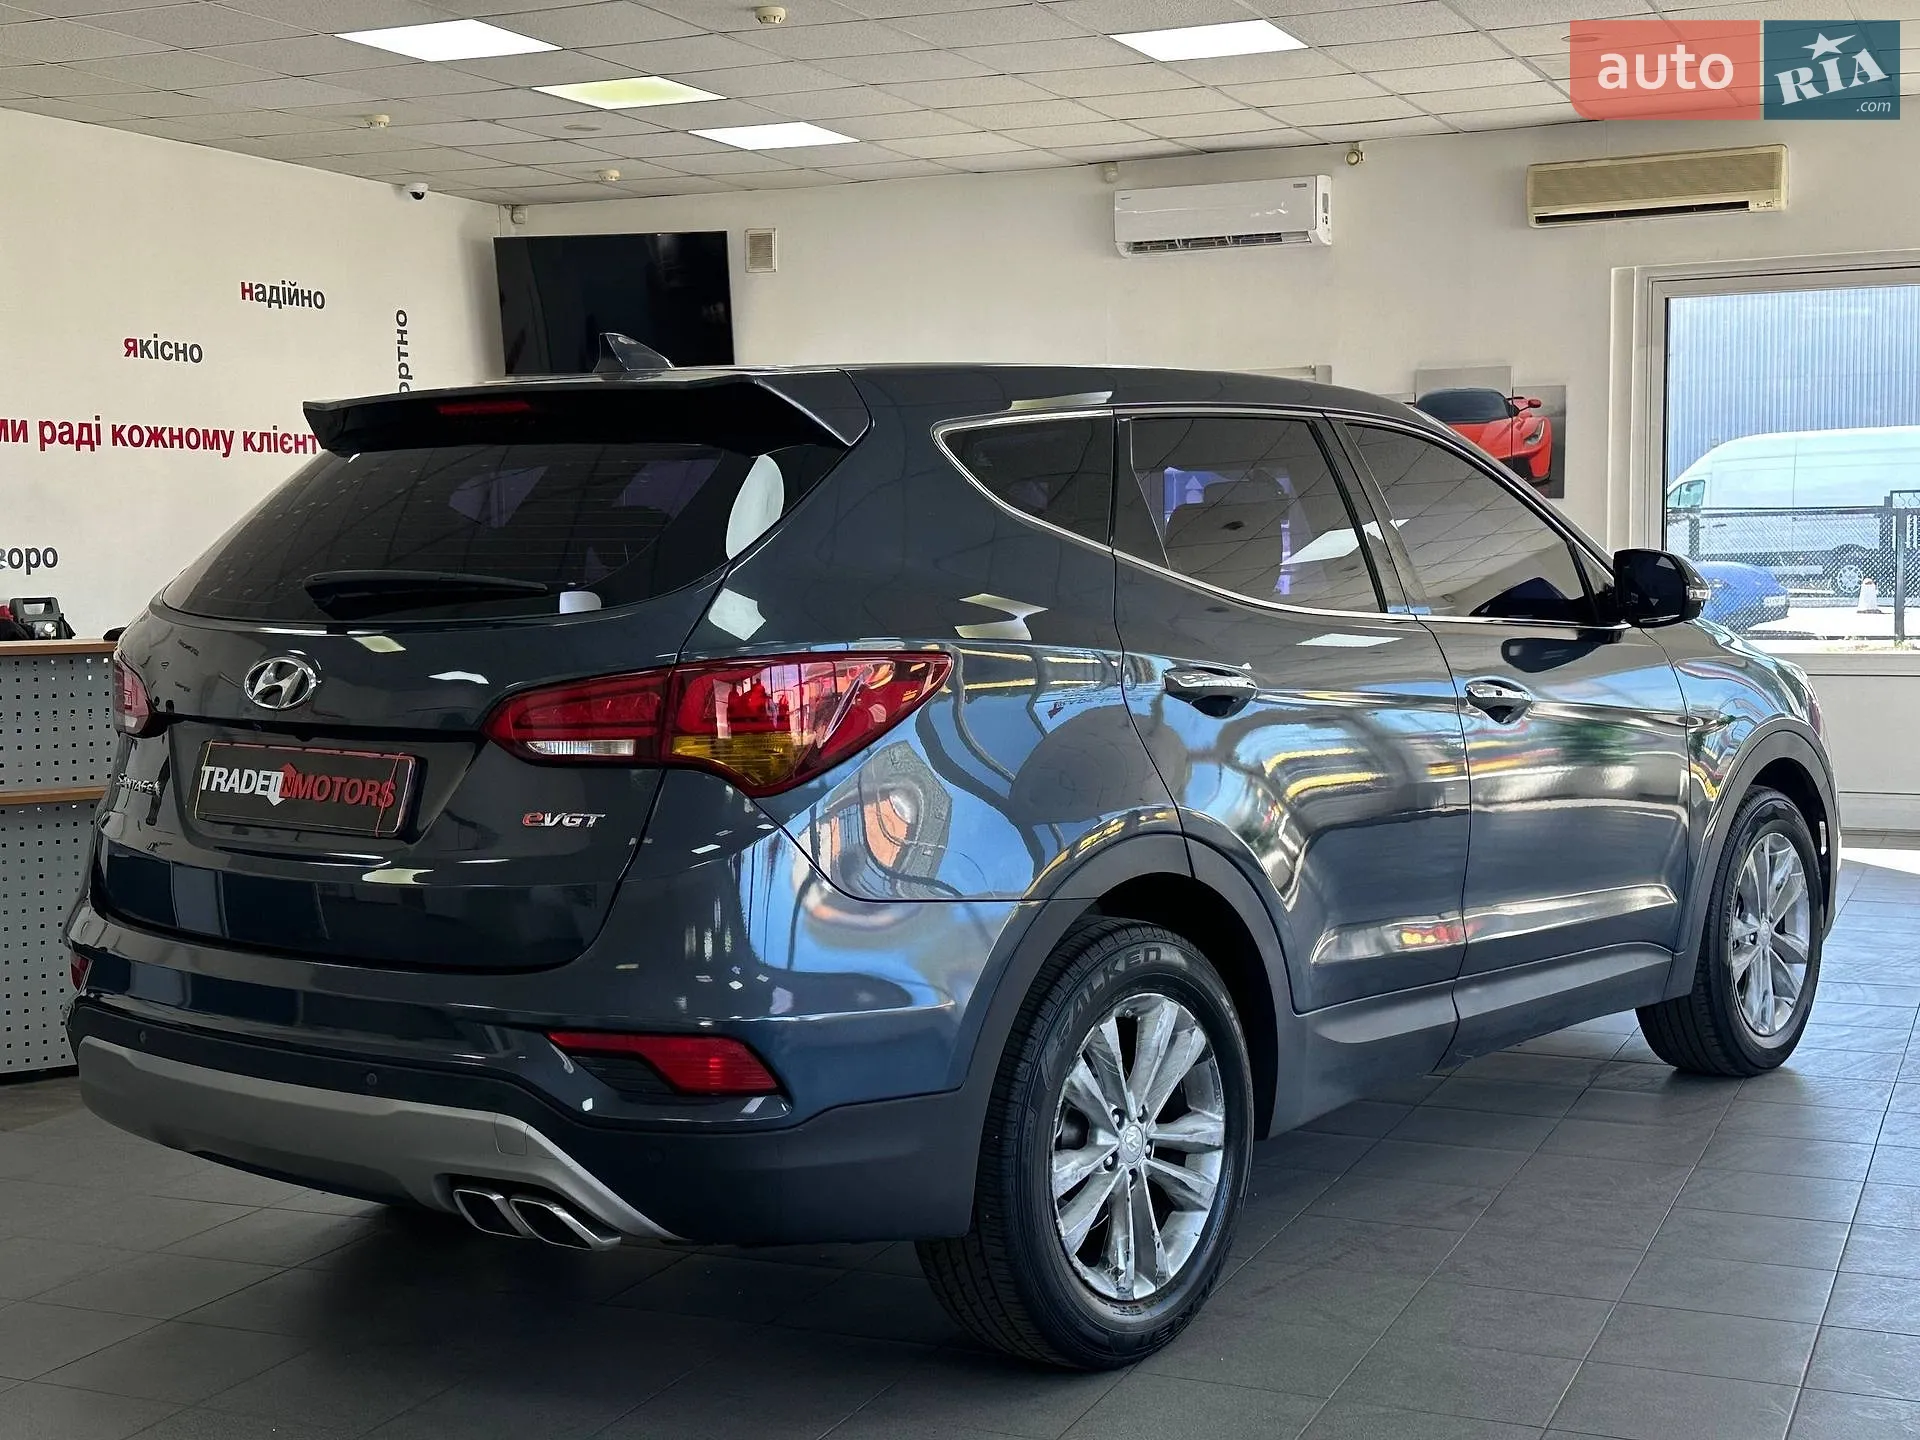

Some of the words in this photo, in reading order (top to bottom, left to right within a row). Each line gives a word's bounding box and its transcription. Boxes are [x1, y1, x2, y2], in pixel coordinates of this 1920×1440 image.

[240, 280, 326, 310] надійно
[123, 333, 203, 364] якісно
[38, 415, 102, 452] раді
[111, 424, 235, 458] кожному
